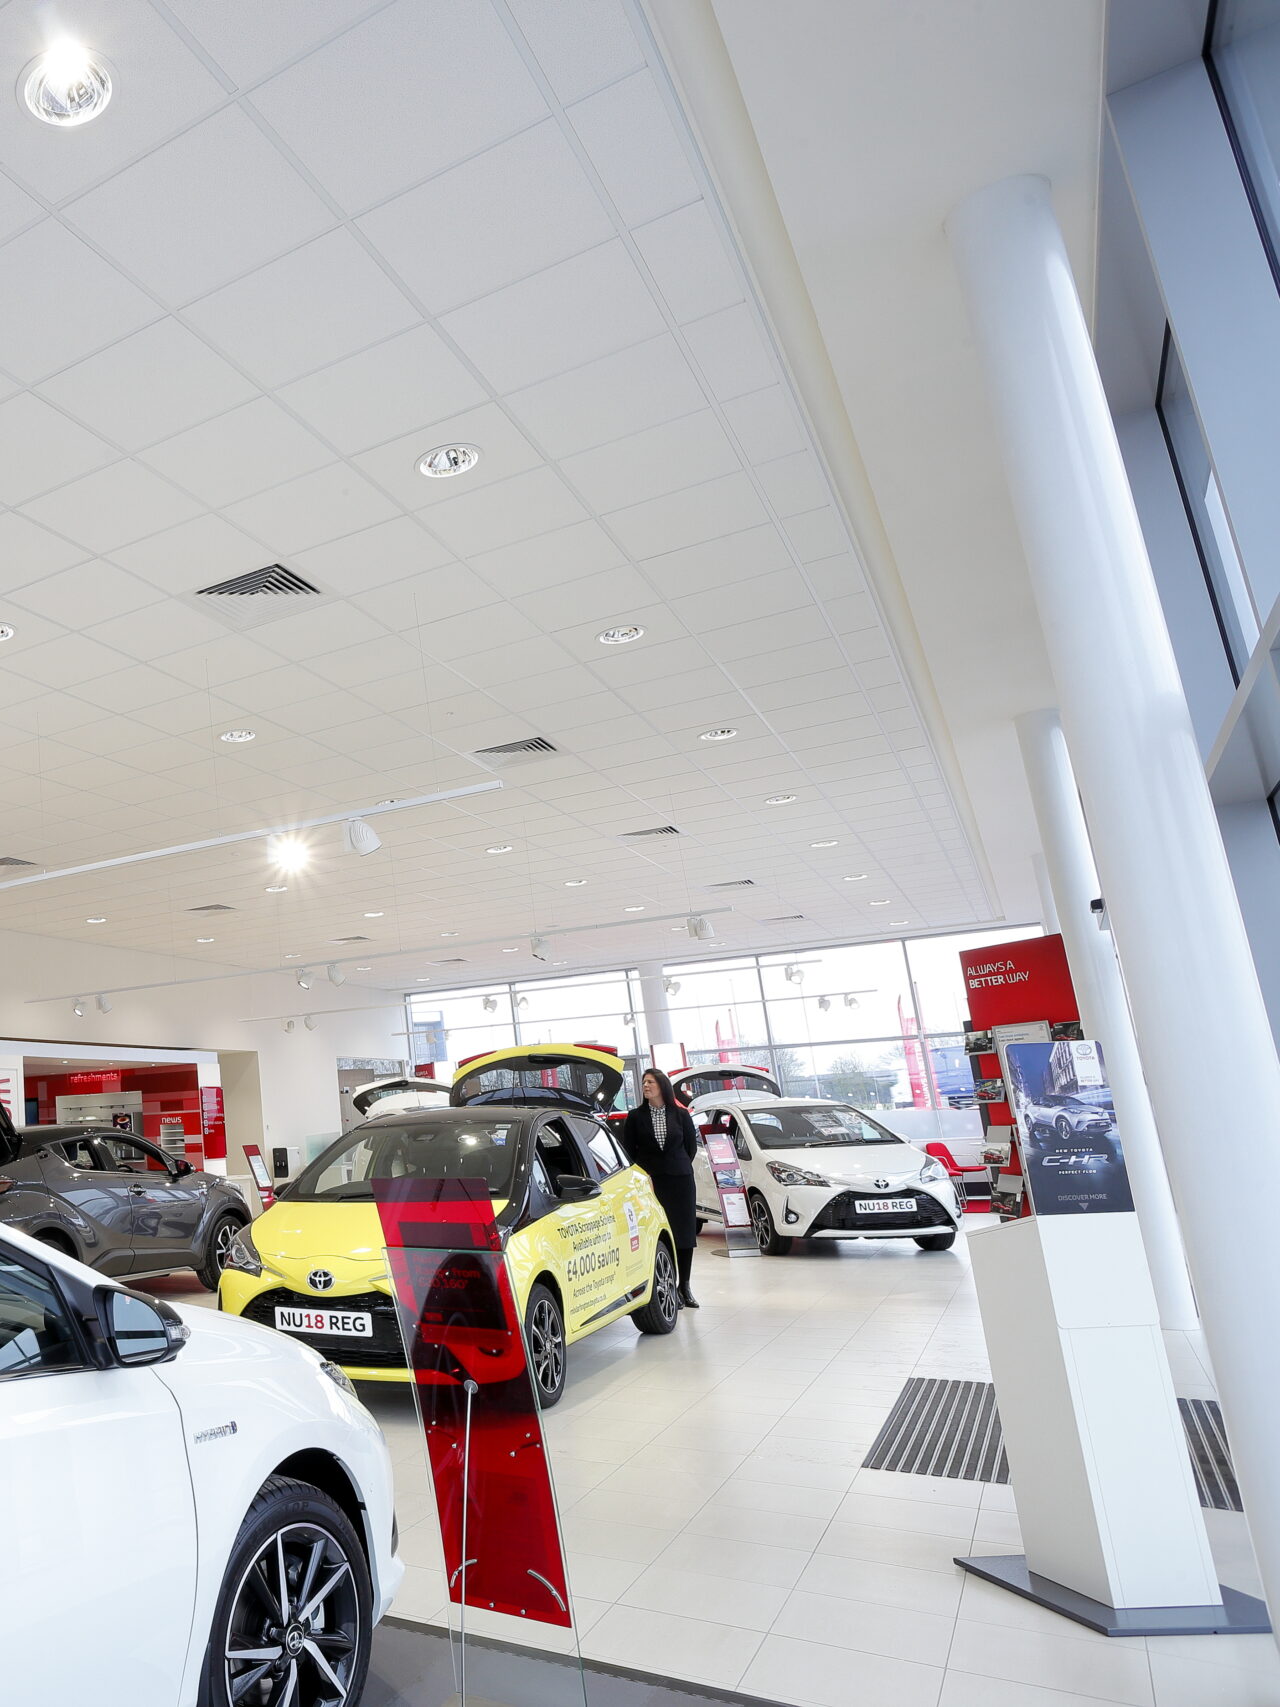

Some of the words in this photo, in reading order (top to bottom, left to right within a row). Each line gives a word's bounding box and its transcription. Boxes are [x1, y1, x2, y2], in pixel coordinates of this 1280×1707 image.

[967, 962, 1005, 977] ALWAYS
[1006, 960, 1015, 971] A
[969, 974, 1006, 989] BETTER
[1005, 971, 1029, 984] WAY
[70, 1072, 118, 1084] refreshments
[161, 1116, 182, 1124] news
[1041, 1153, 1110, 1167] C-HR
[858, 1201, 889, 1211] NU18
[891, 1200, 913, 1210] REG
[557, 1224, 580, 1239] TOYOTA
[578, 1219, 601, 1233] Scrappage
[600, 1214, 616, 1228] Scheme
[572, 1237, 593, 1252] Available
[567, 1251, 596, 1282] £4,000
[597, 1245, 619, 1269] saving
[280, 1311, 325, 1330] NU18
[329, 1315, 366, 1332] REG
[193, 1424, 232, 1444] HYBRID
